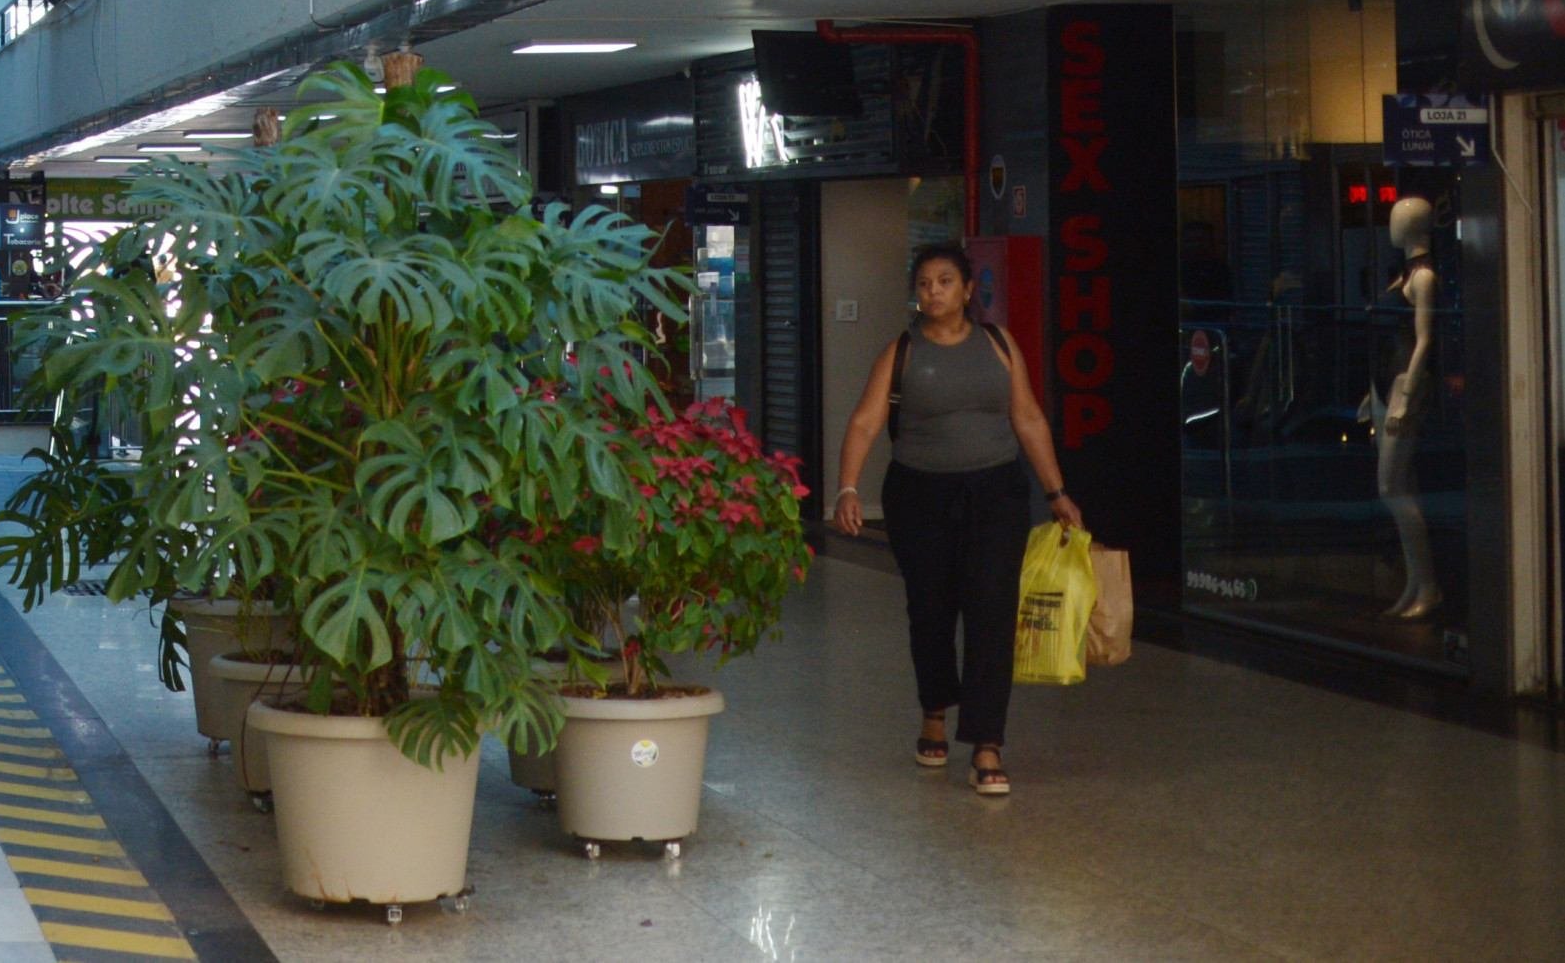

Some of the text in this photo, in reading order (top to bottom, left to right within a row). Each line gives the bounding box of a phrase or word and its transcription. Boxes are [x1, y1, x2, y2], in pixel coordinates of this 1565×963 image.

[1427, 110, 1455, 121] LOJA
[1057, 20, 1114, 450] SEX SHOP
